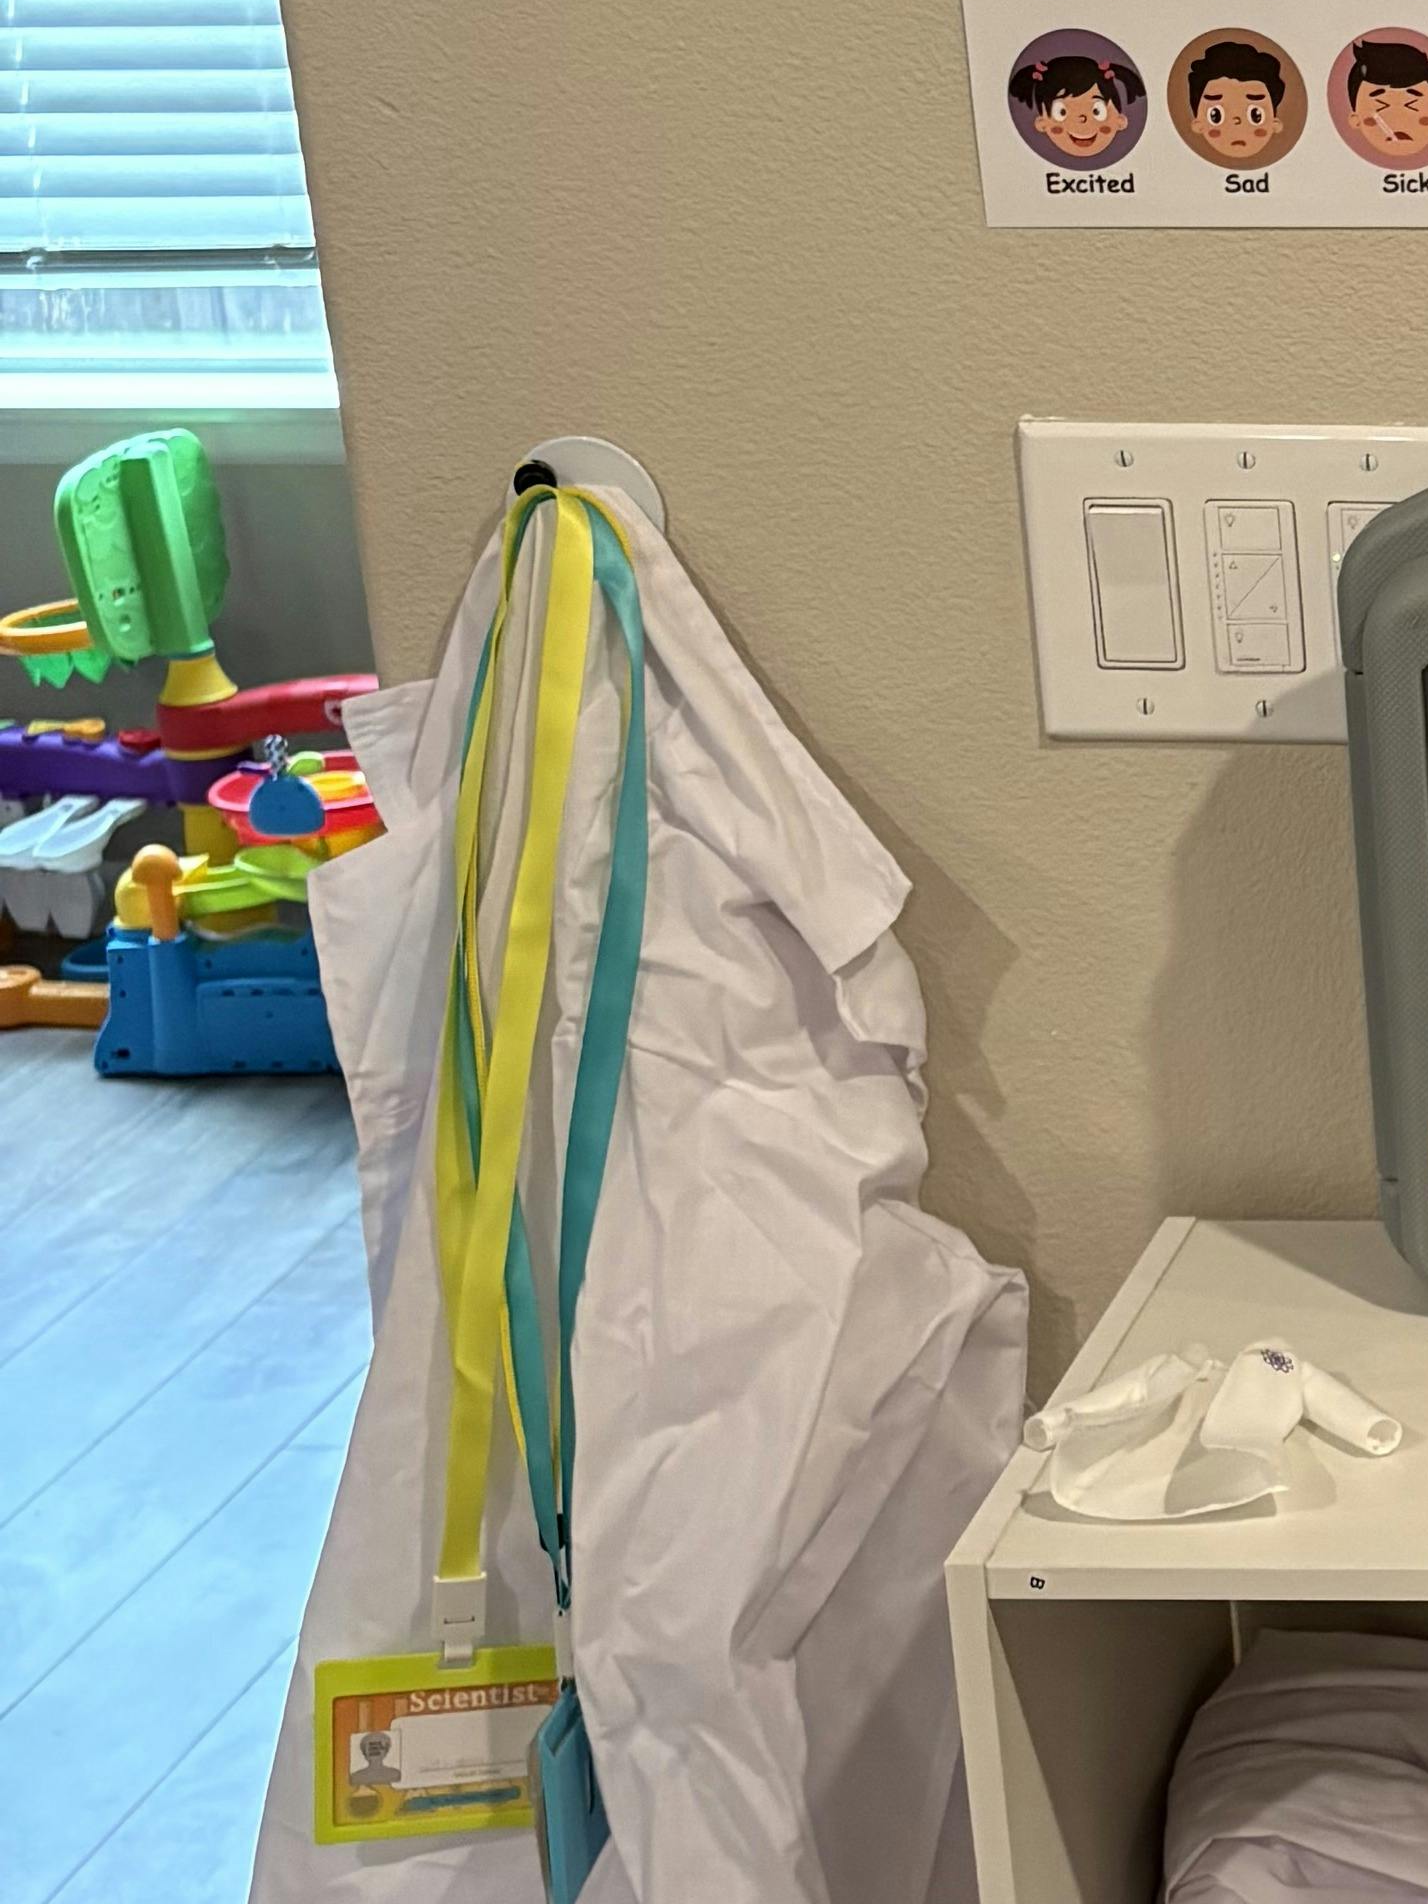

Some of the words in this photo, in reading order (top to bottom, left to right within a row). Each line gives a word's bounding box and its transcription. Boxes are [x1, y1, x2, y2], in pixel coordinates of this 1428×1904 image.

[1046, 173, 1135, 195] Excited
[1225, 174, 1270, 194] Sad
[1030, 1576, 1045, 1590] B
[410, 1683, 538, 1713] Scientist
